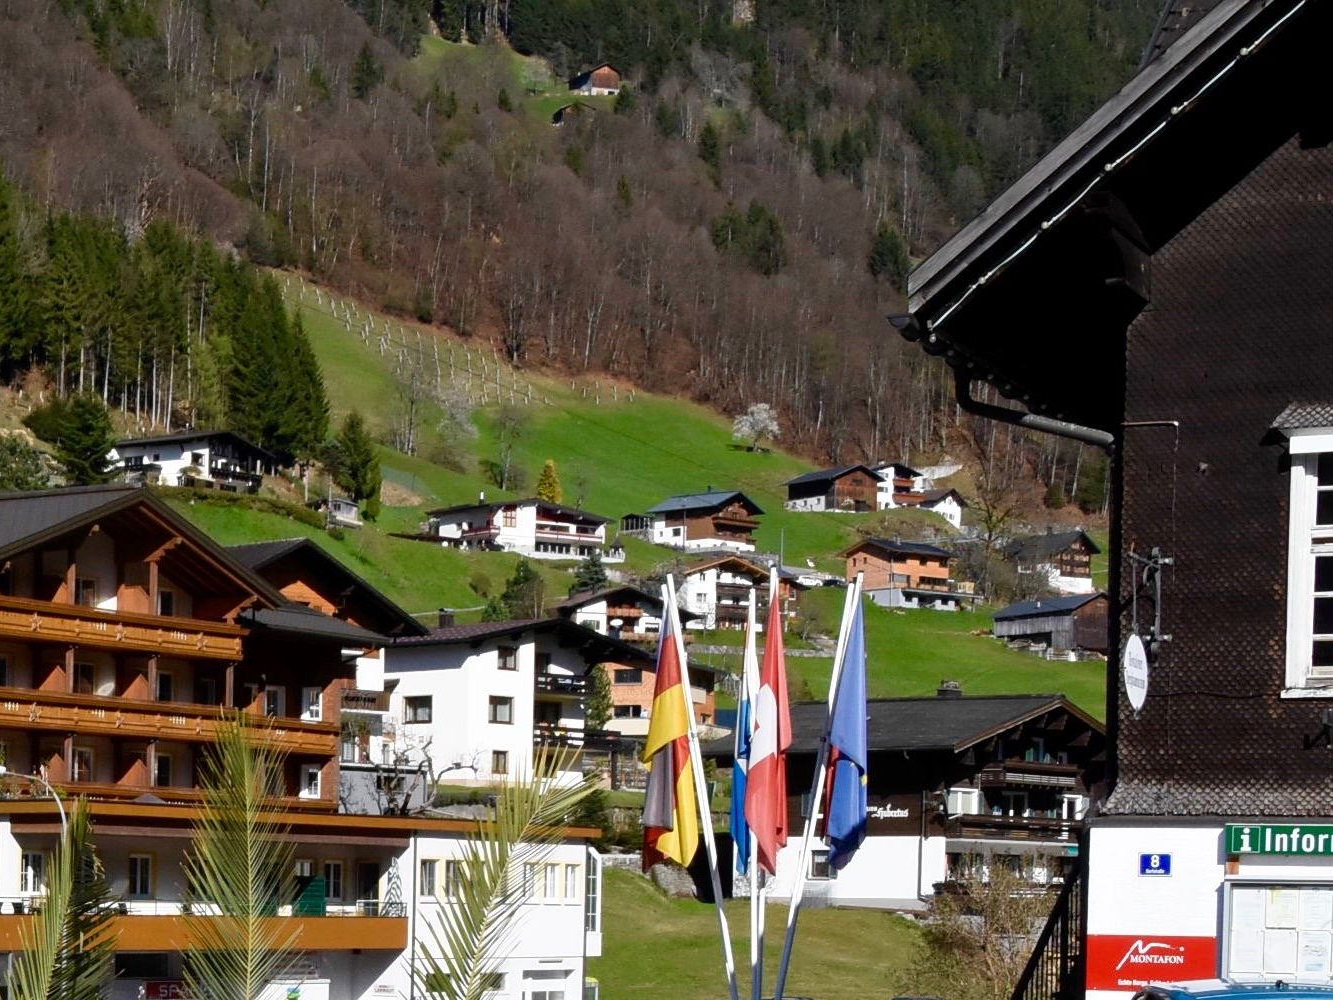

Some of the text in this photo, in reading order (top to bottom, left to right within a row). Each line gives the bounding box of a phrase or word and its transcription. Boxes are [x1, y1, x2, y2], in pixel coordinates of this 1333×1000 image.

[1265, 827, 1333, 853] Infor
[1150, 854, 1160, 868] 8
[1130, 954, 1184, 964] MONTAFON
